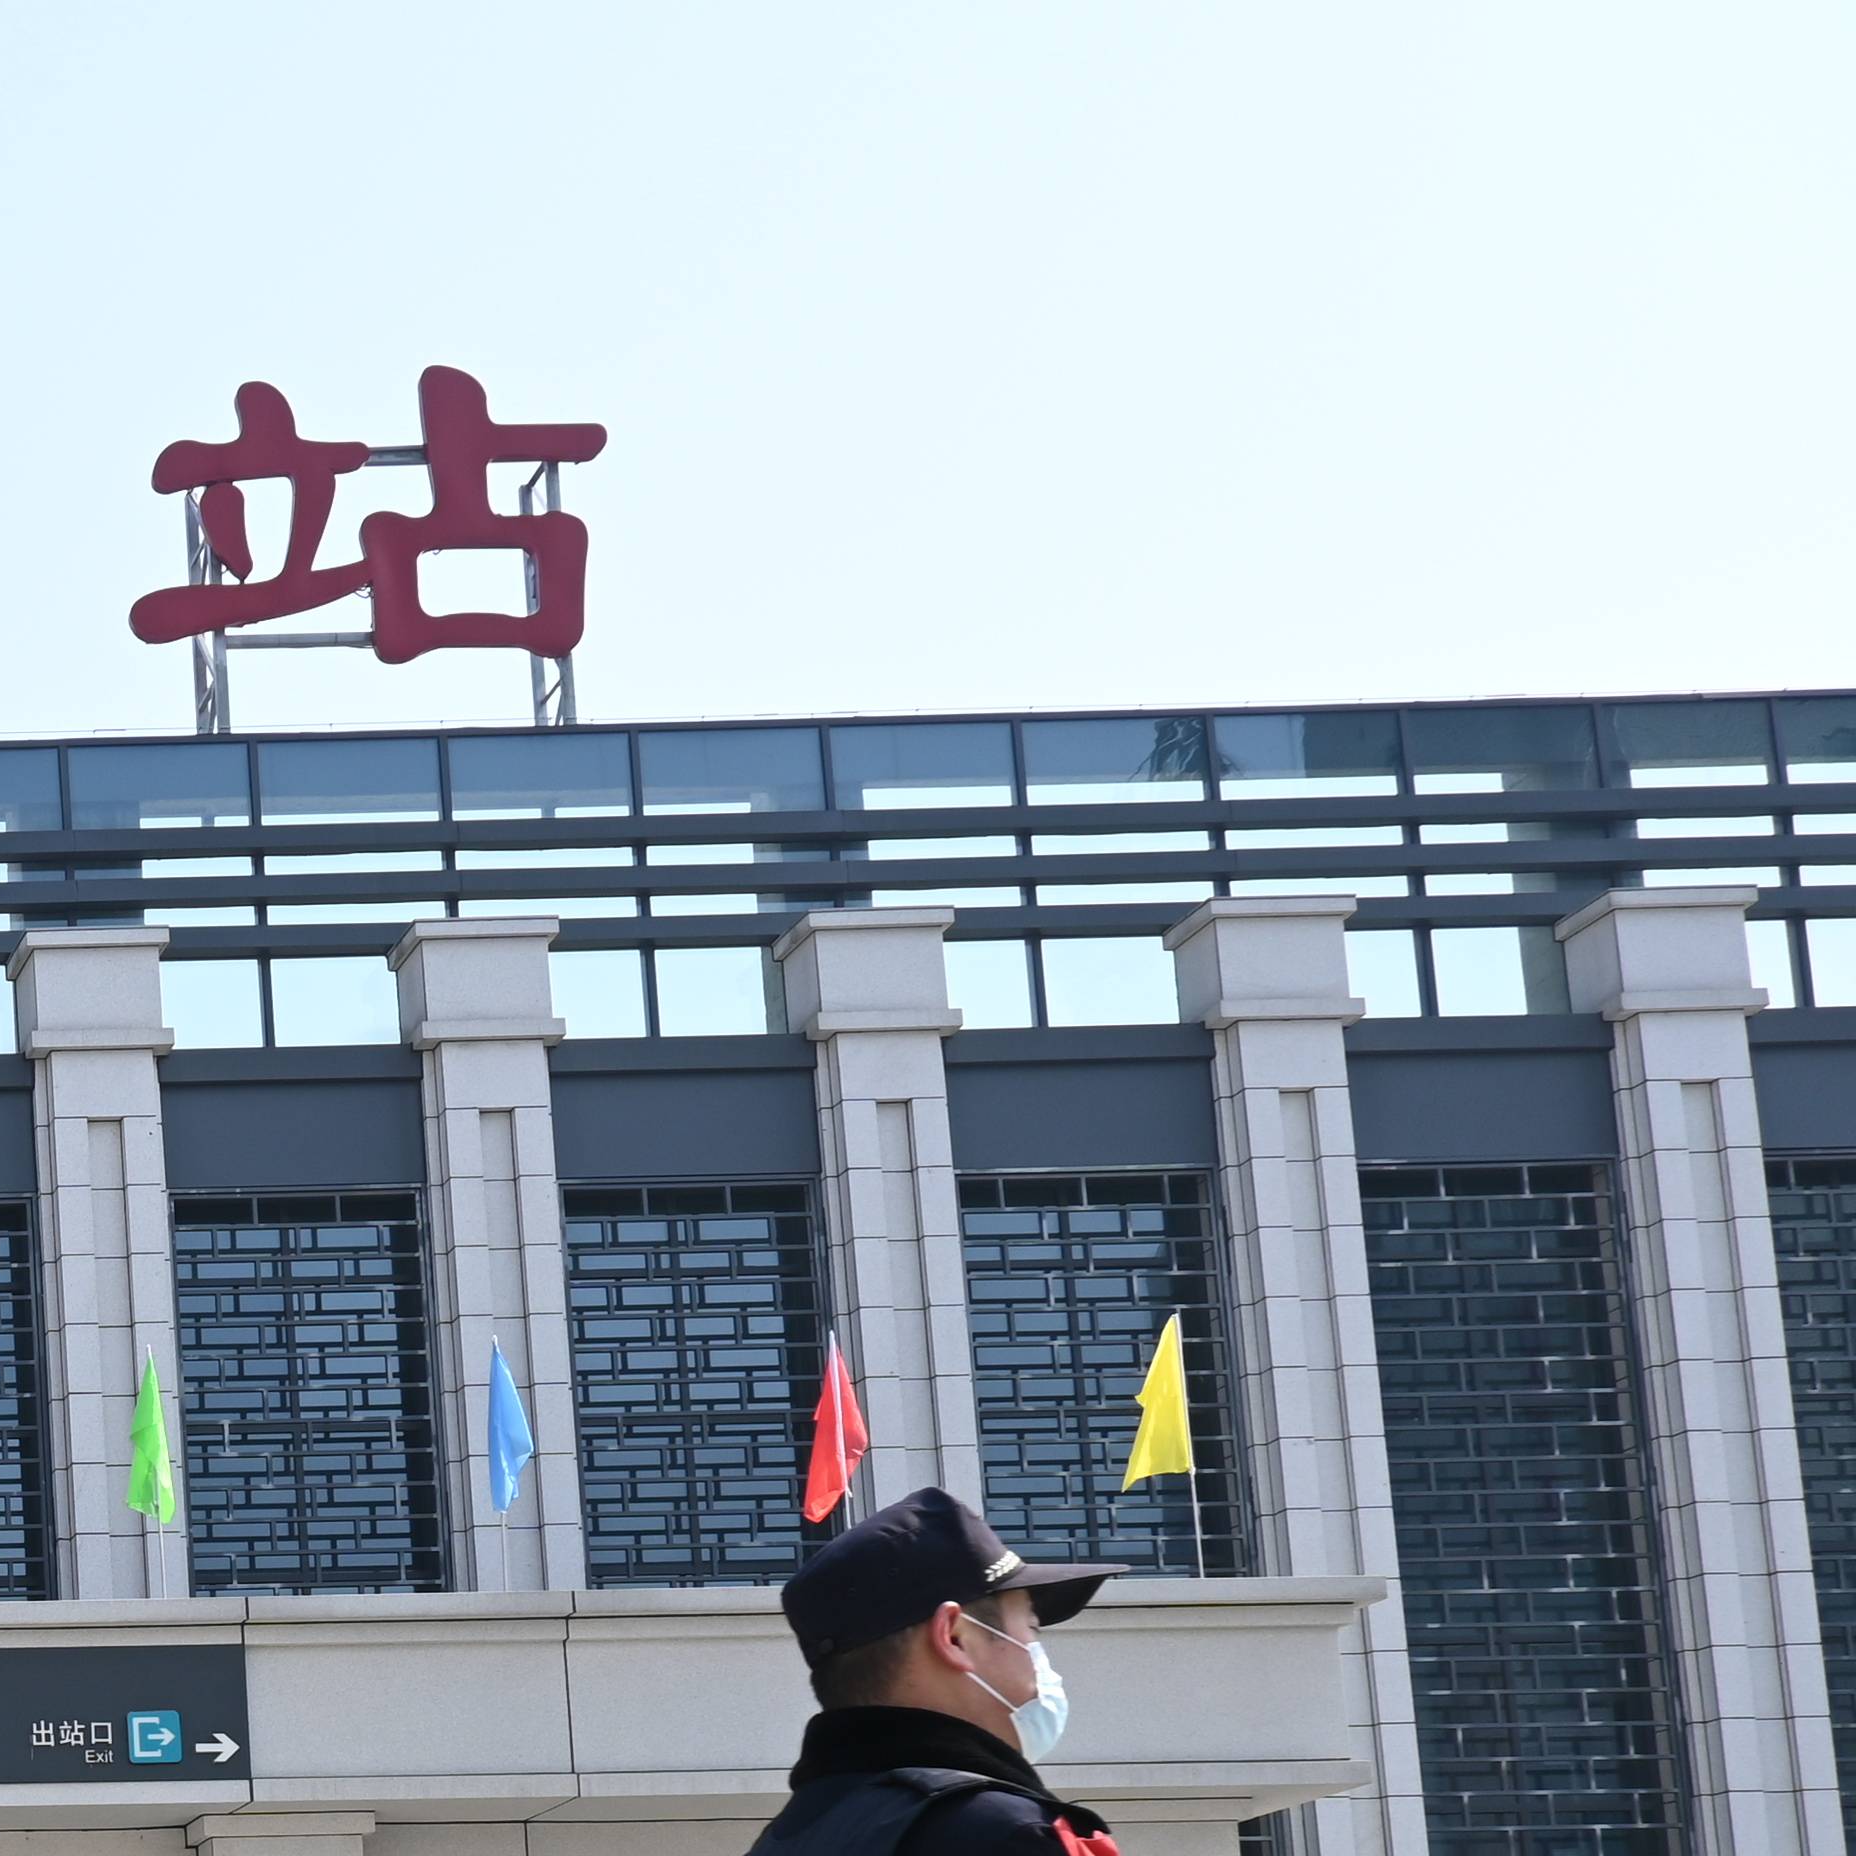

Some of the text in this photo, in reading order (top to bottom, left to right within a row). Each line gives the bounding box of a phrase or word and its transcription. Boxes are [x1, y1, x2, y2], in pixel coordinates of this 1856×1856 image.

[32, 1720, 113, 1747] 出站口
[85, 1750, 114, 1763] Exit
